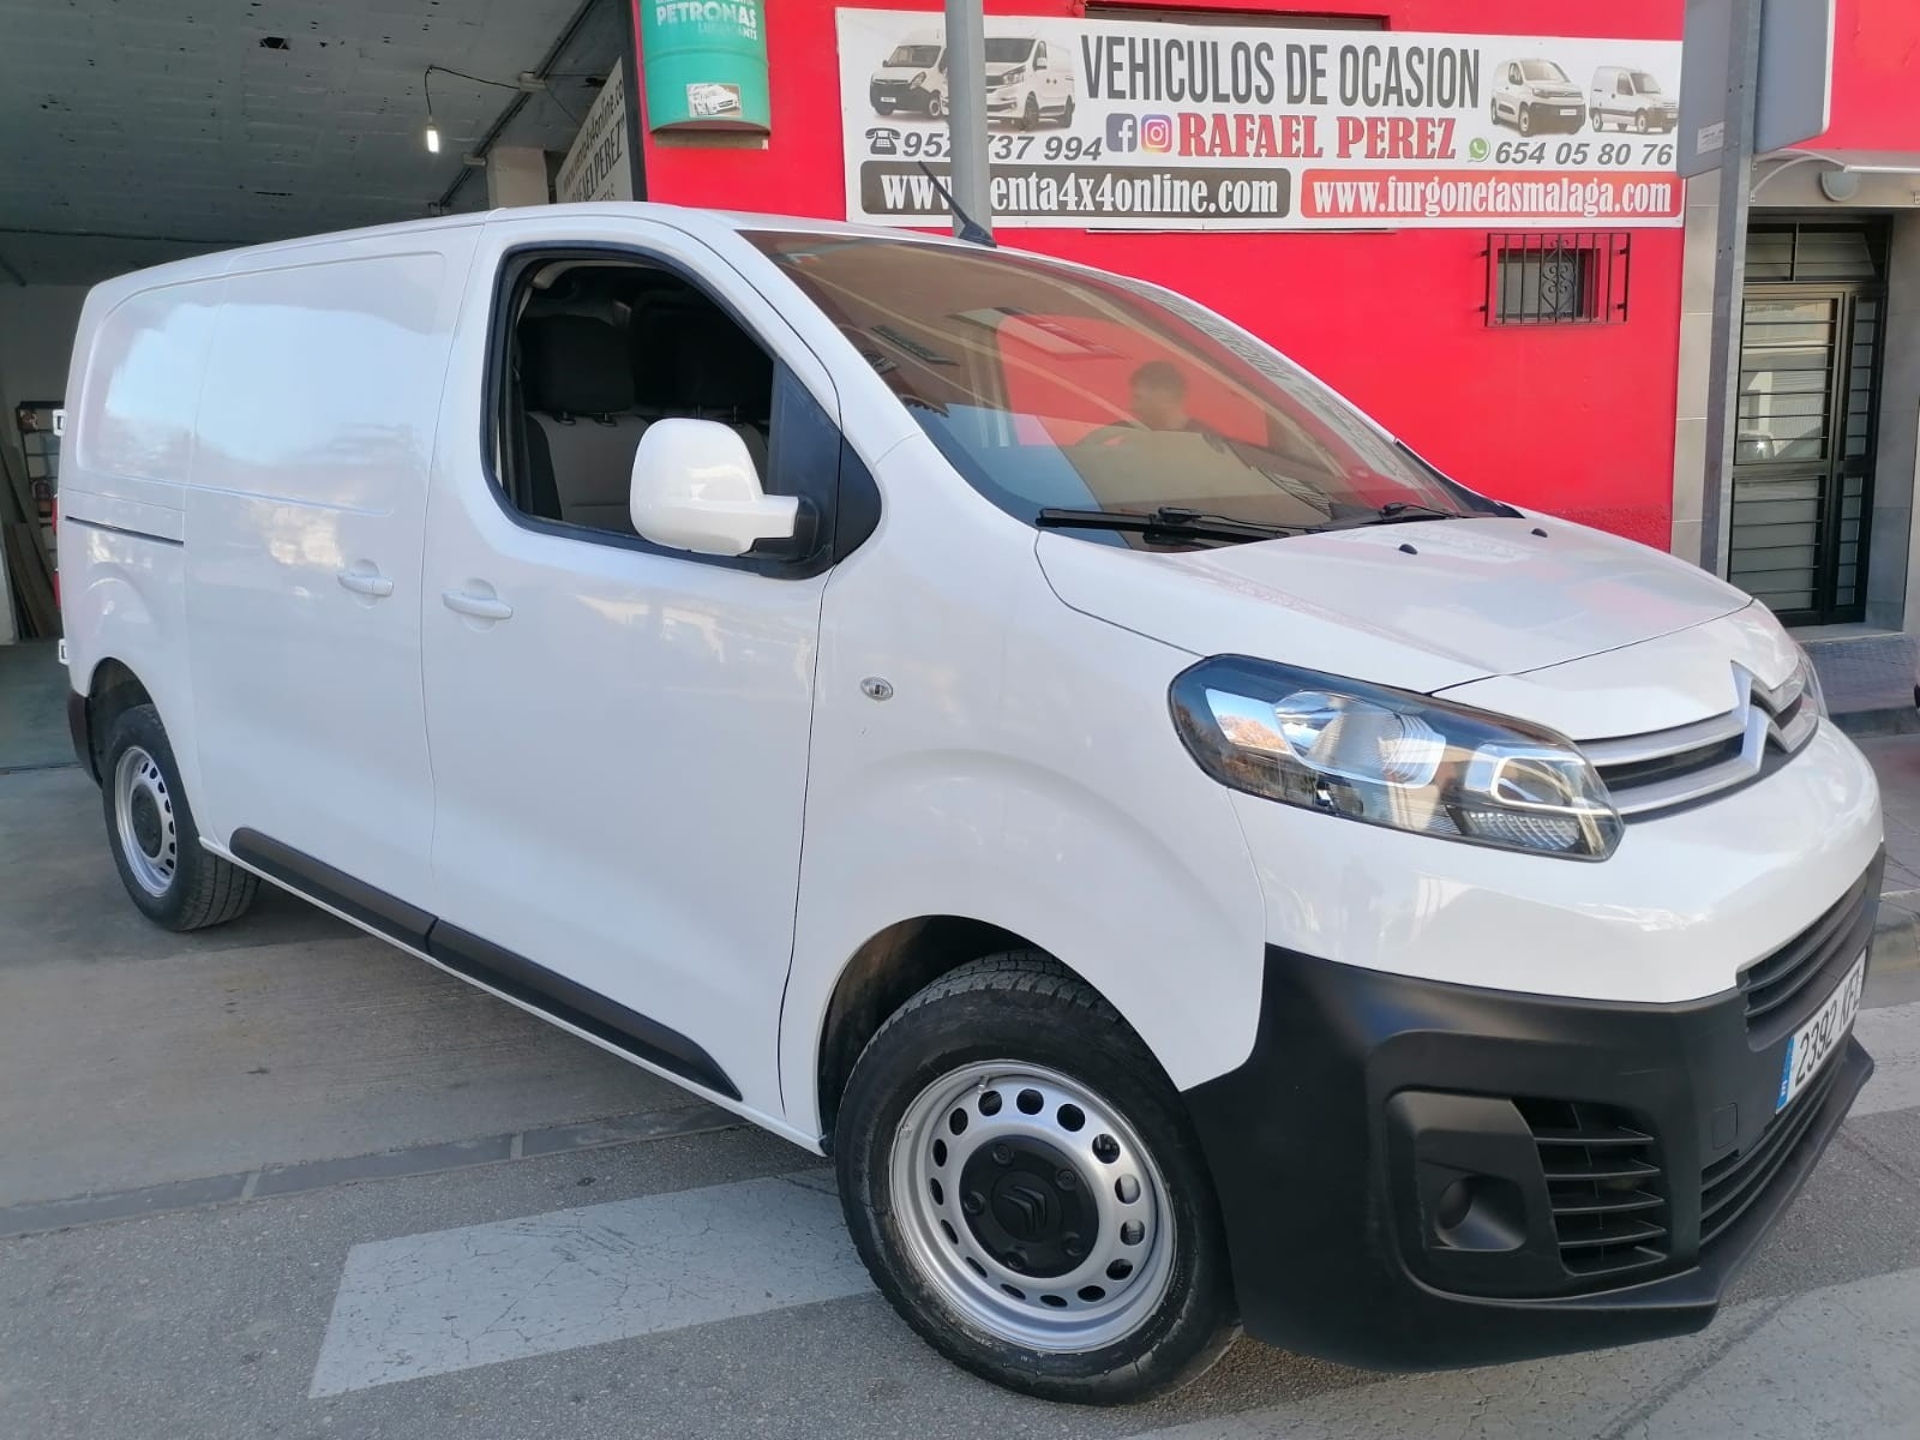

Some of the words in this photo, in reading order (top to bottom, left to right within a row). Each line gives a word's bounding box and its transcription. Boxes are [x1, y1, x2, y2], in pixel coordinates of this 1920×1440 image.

[656, 1, 757, 29] PETRONAS
[1080, 34, 1275, 105] VEHICULOS
[1286, 43, 1328, 106] DE
[1339, 46, 1480, 109] OCASION
[986, 135, 1035, 160] 37
[1044, 136, 1102, 161] 994
[1177, 112, 1324, 158] RAFAEL
[1336, 117, 1457, 160] PEREZ
[1495, 141, 1546, 166] 654
[1555, 141, 1588, 166] 05
[1597, 142, 1631, 166] 80
[1641, 142, 1673, 166] 76
[1313, 176, 1671, 218] www.furgonetasmalaga.com
[1795, 998, 1838, 1088] 2392
